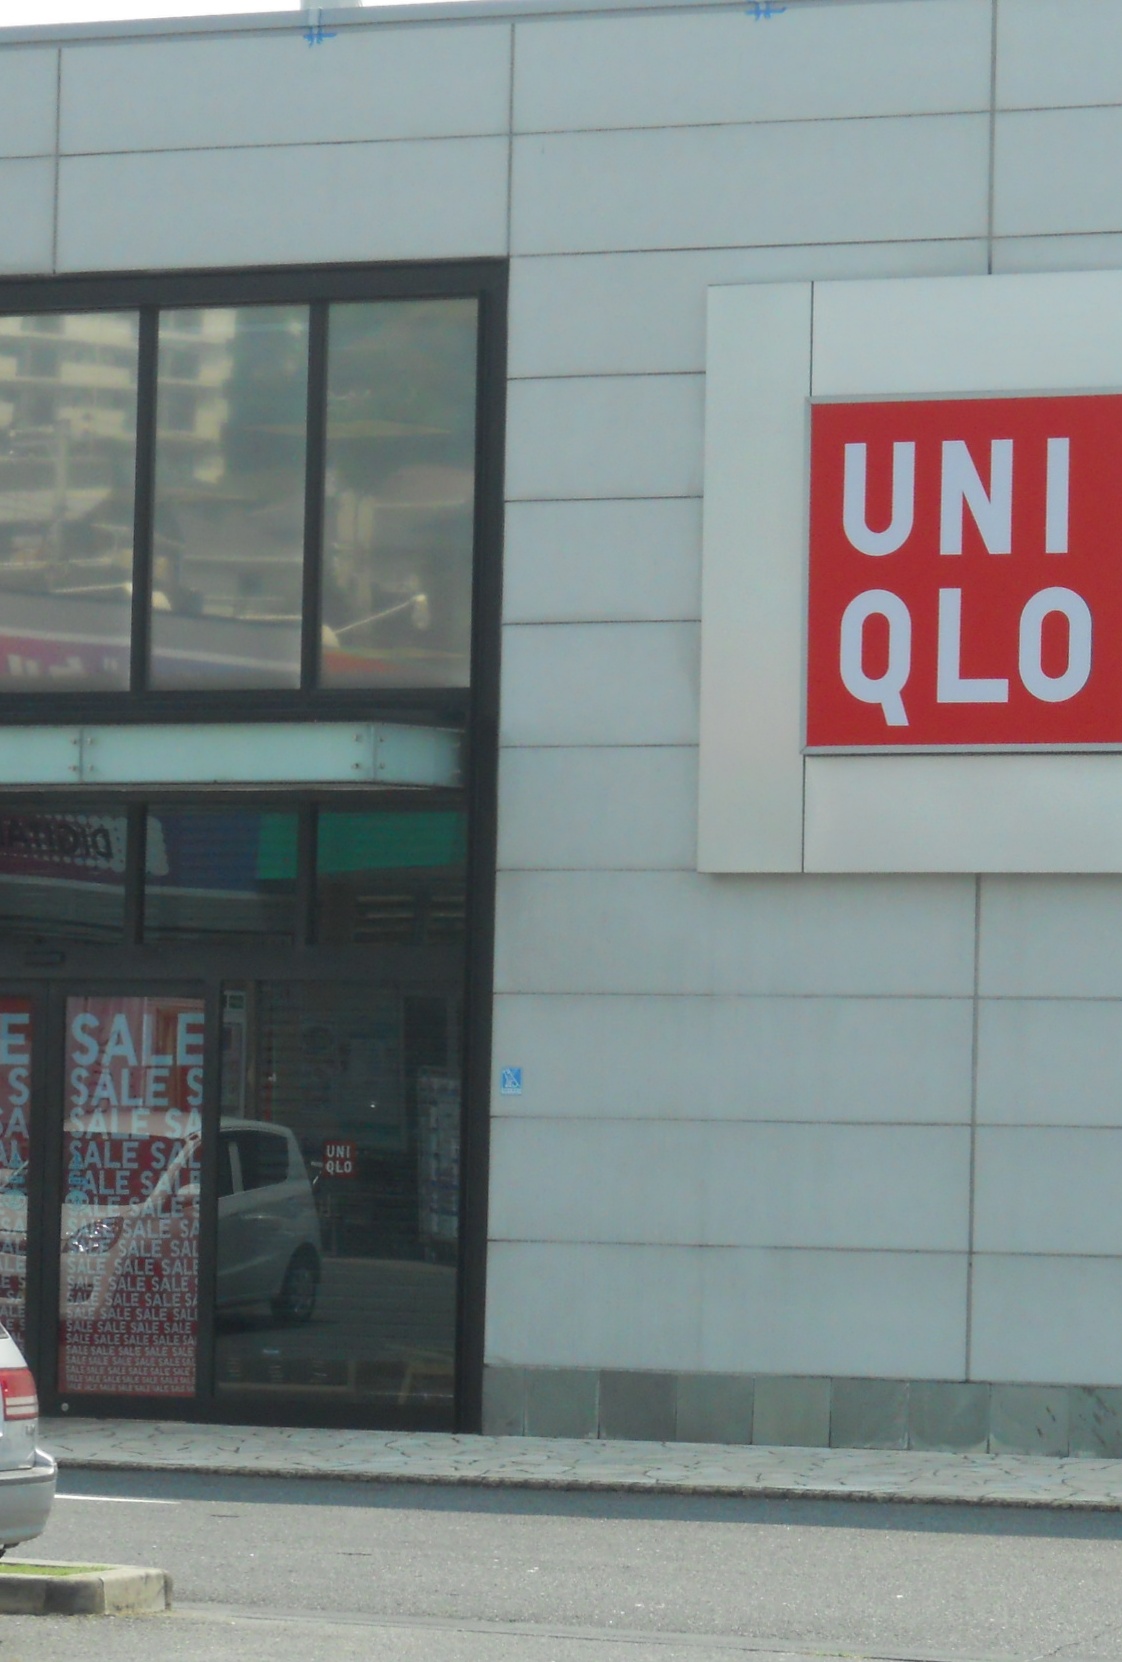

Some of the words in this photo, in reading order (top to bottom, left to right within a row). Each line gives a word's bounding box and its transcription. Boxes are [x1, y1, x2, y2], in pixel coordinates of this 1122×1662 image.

[842, 437, 1070, 557] UNI
[839, 586, 1093, 726] QLO
[71, 1012, 205, 1066] SALE
[70, 1067, 170, 1106] SALE
[69, 1107, 151, 1139] SALE
[69, 1141, 139, 1168] SALE
[326, 1145, 351, 1158] UNI
[325, 1160, 352, 1175] QLO
[122, 1219, 171, 1239] SALE
[118, 1240, 162, 1257] SALE
[67, 1258, 106, 1274] SALE
[114, 1258, 155, 1274] SALE
[67, 1276, 102, 1290] SALE
[109, 1277, 145, 1291] SALE
[151, 1277, 189, 1291] SALE
[105, 1292, 139, 1306] SALE
[144, 1293, 180, 1307] SALE
[66, 1308, 95, 1320] SALE
[100, 1308, 131, 1320] SALE
[136, 1308, 167, 1320] SALE
[66, 1321, 92, 1333] SALE
[97, 1322, 126, 1333] SALE
[130, 1322, 159, 1334] SALE
[164, 1322, 191, 1334] SALE
[66, 1333, 90, 1344] SALE
[94, 1334, 120, 1345] SALE
[122, 1334, 149, 1345] SALE
[153, 1334, 179, 1346] SALE
[66, 1346, 88, 1356] SALE
[90, 1346, 115, 1356] SALE
[117, 1346, 141, 1356] SALE
[144, 1347, 168, 1357] SALE
[172, 1347, 193, 1357] SALE
